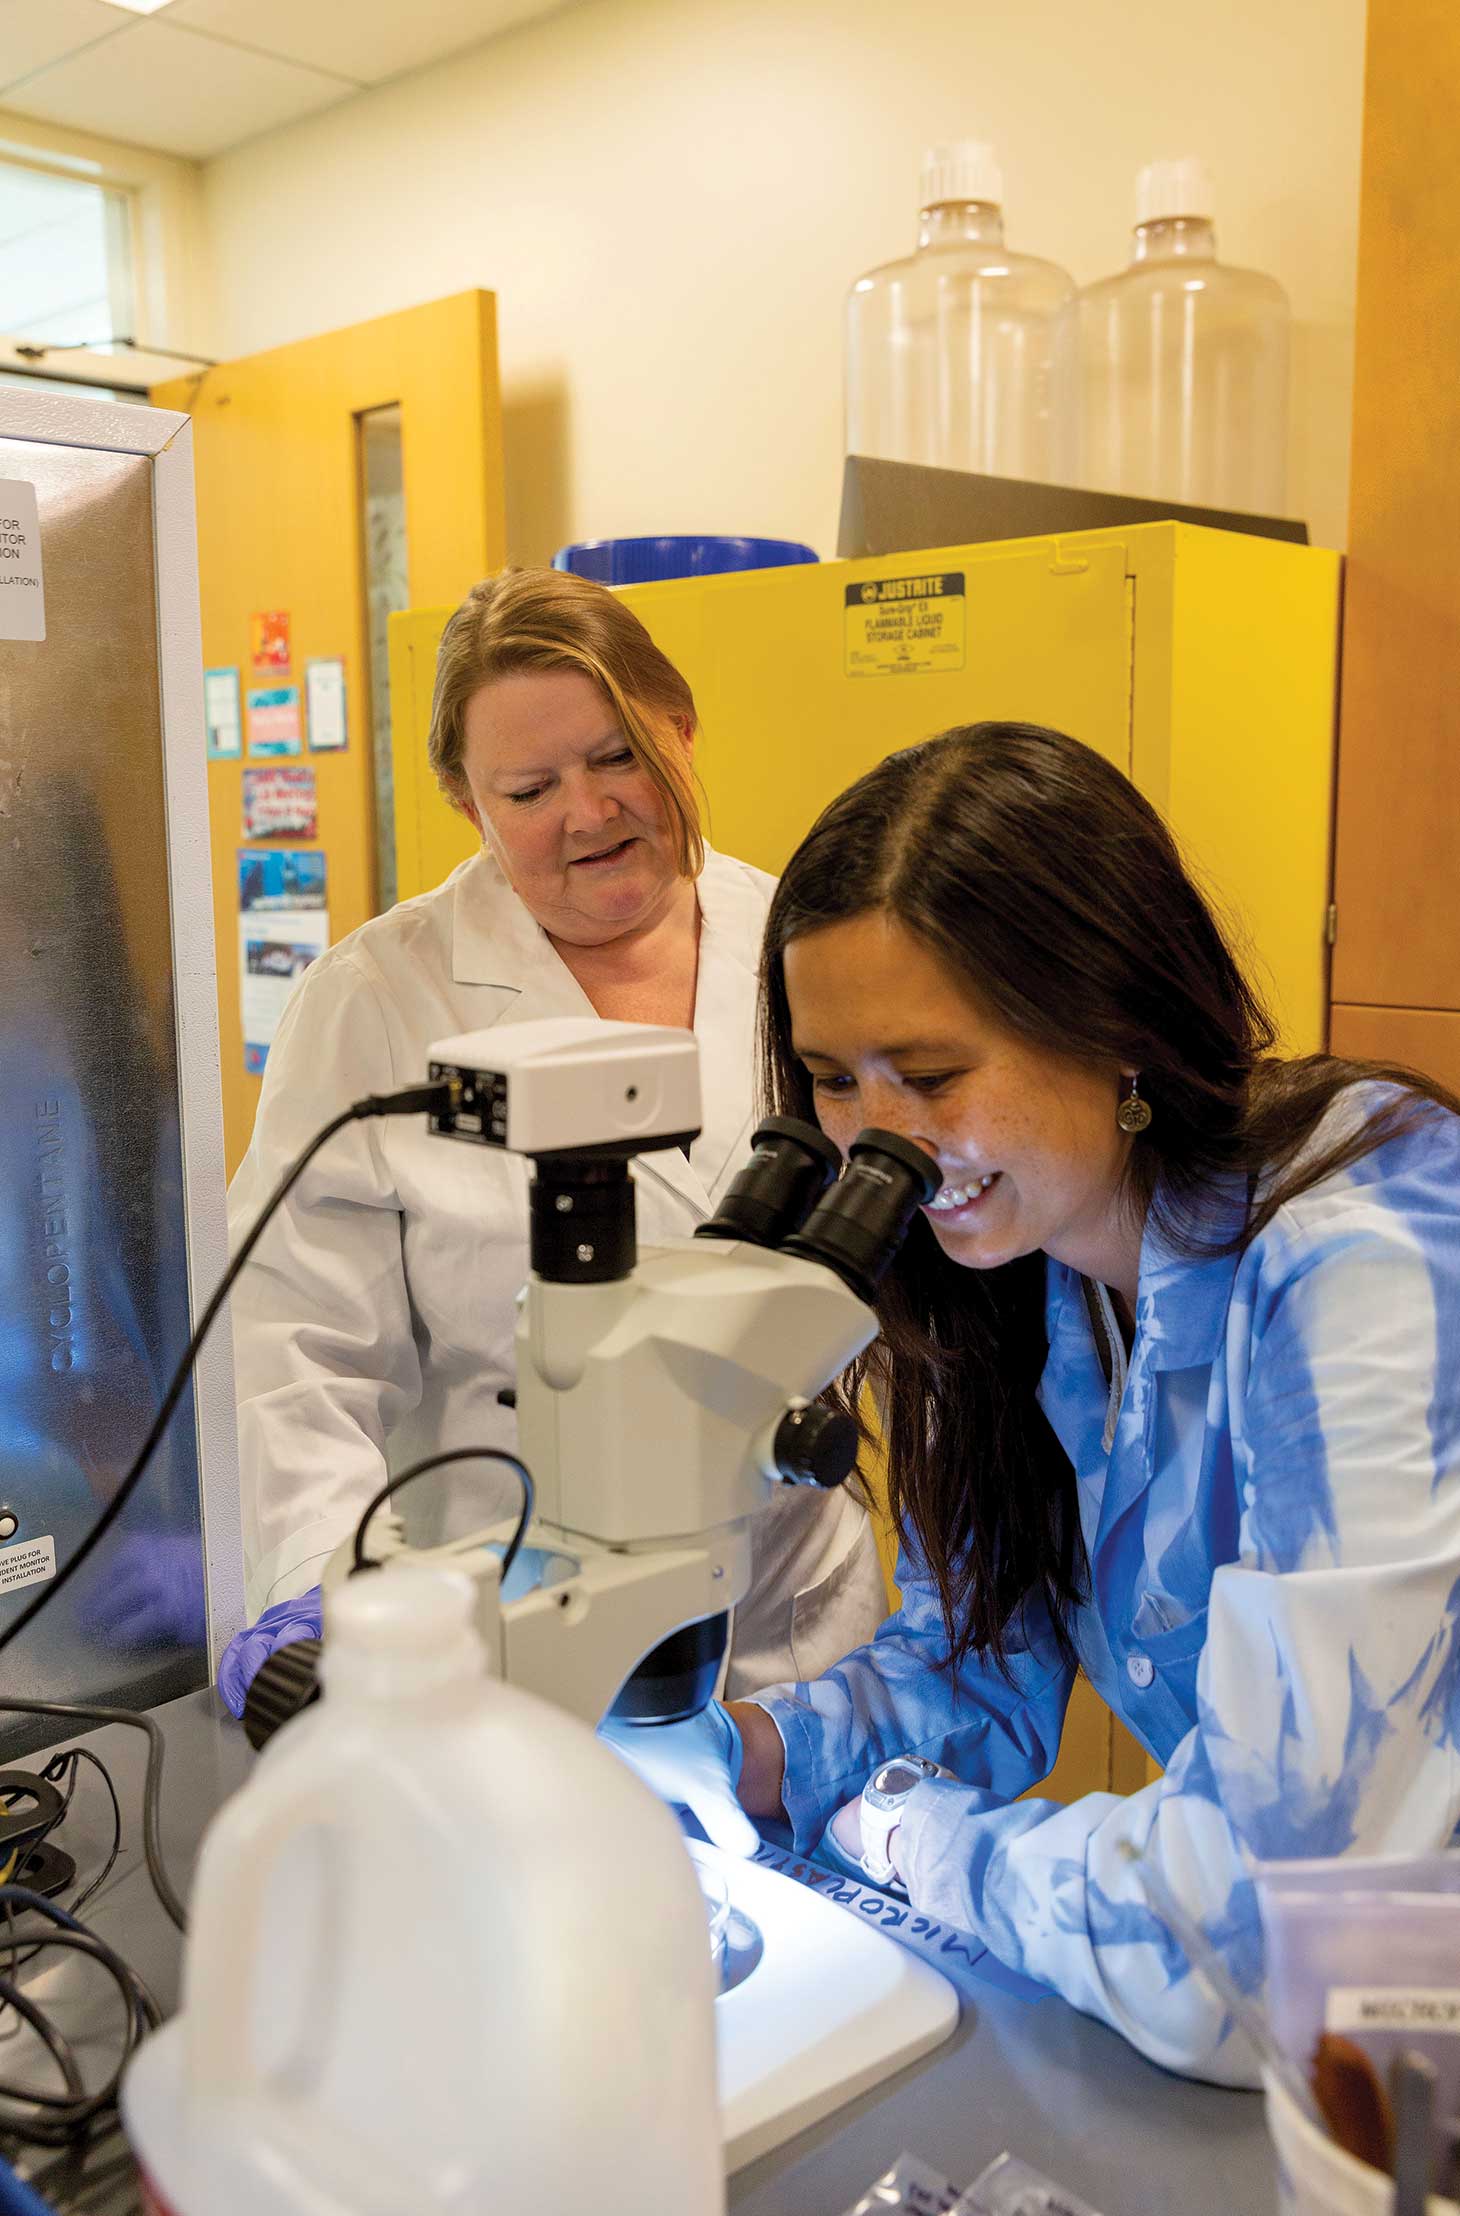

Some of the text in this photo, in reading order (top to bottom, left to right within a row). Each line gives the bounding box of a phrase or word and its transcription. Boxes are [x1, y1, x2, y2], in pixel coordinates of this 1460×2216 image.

[0, 519, 20, 530] OR
[878, 576, 944, 600] JUSTRITE
[865, 613, 943, 629] FLAMMABLE LIQUID
[866, 627, 942, 643] STORAGE CABINET
[36, 1099, 74, 1372] CYCLOPENTANE
[0, 1549, 41, 1566] VE PLUG FOR
[20, 1556, 50, 1569] MONITOR
[2, 1566, 46, 1584] INSTALLATION
